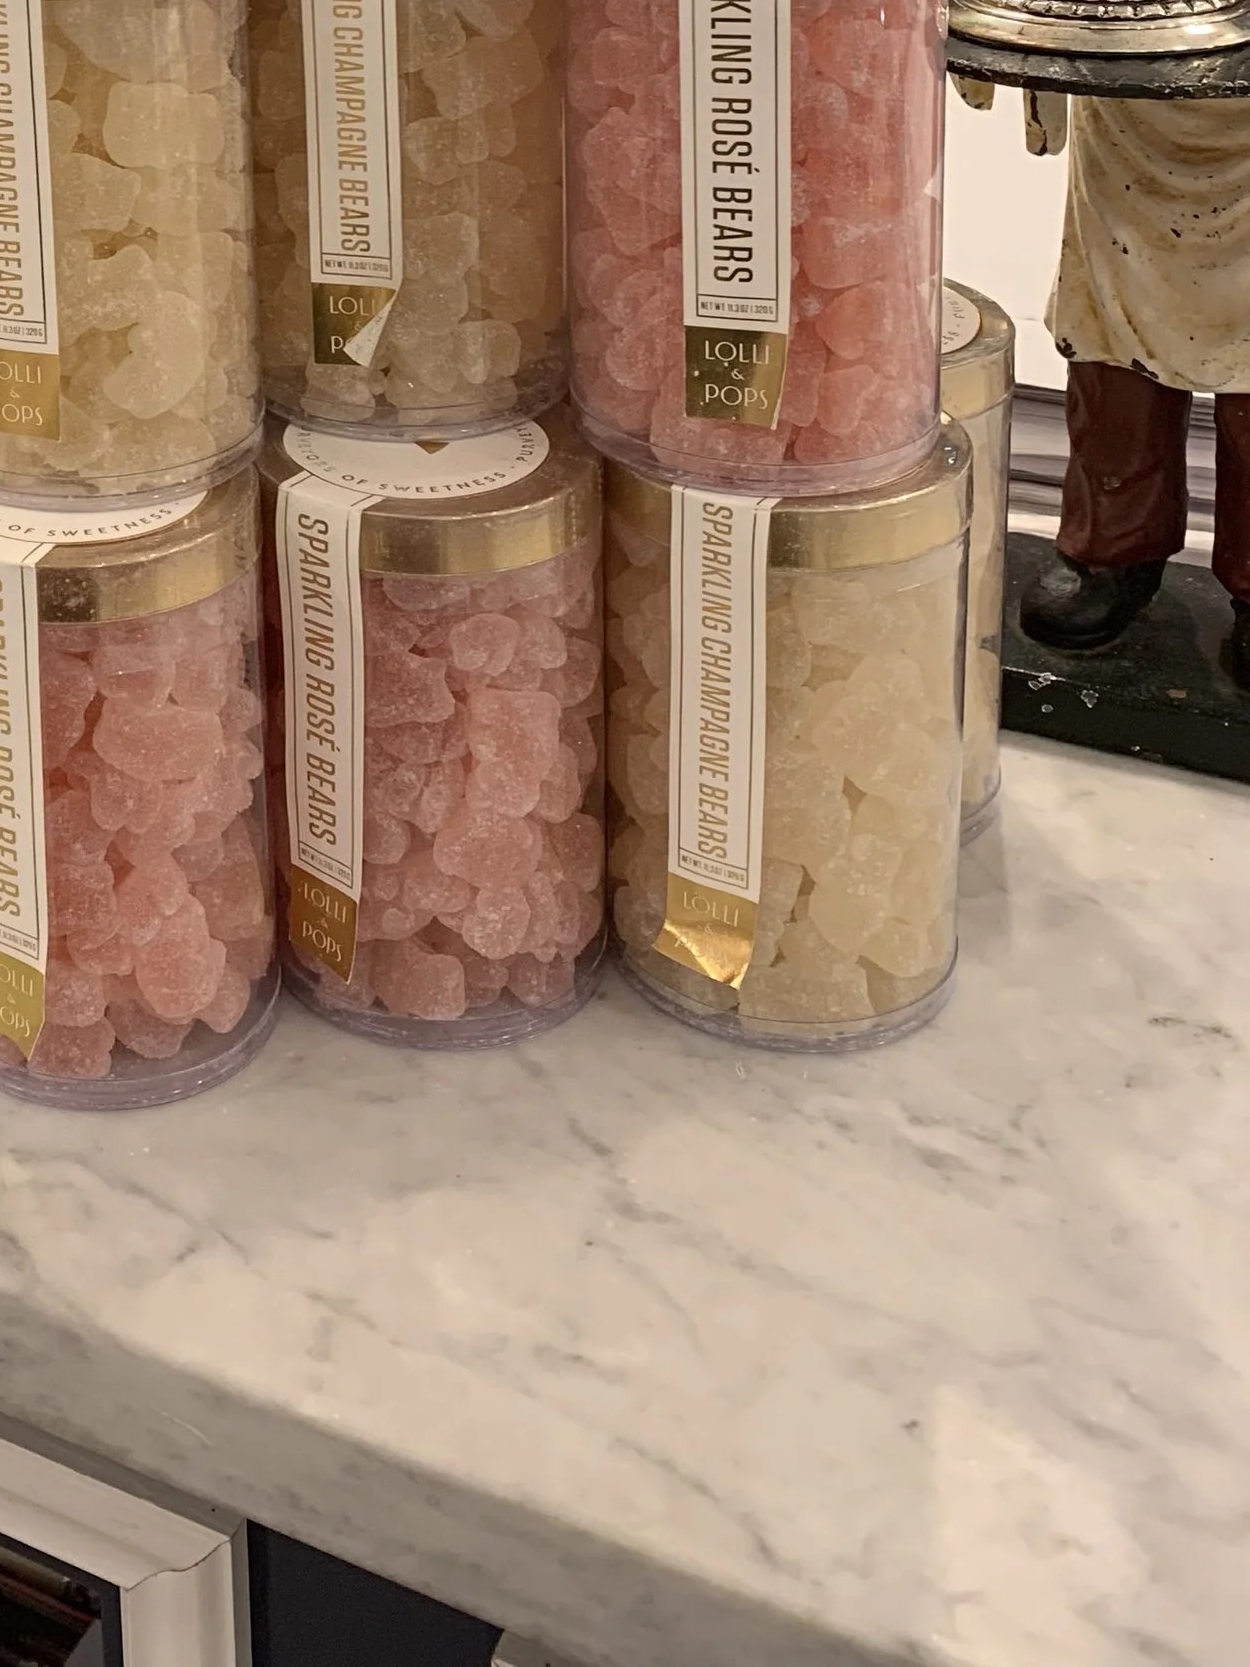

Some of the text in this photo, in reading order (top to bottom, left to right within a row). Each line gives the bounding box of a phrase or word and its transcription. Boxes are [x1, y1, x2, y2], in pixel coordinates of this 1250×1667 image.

[331, 24, 369, 175] CHAMPAGNE
[710, 97, 761, 177] ROSÉ
[337, 177, 372, 255] BEARS
[712, 186, 754, 285] BEARS
[704, 339, 770, 365] LOLLI
[731, 368, 745, 381] &
[704, 383, 769, 410] POPS
[340, 469, 507, 494] OF SWEETNESS
[8, 523, 37, 535] OF
[45, 506, 174, 537] SWEETNESS
[297, 513, 337, 672] SPARKLING
[701, 501, 734, 634] SPARKLING
[305, 669, 343, 754] ROSÉ
[698, 633, 732, 780] CHAMPAGNE
[305, 753, 338, 849] BEARS
[696, 777, 730, 861] BEARS
[301, 920, 343, 963] POPS
[304, 881, 347, 924] LOLLI
[682, 890, 739, 928] LOLLI
